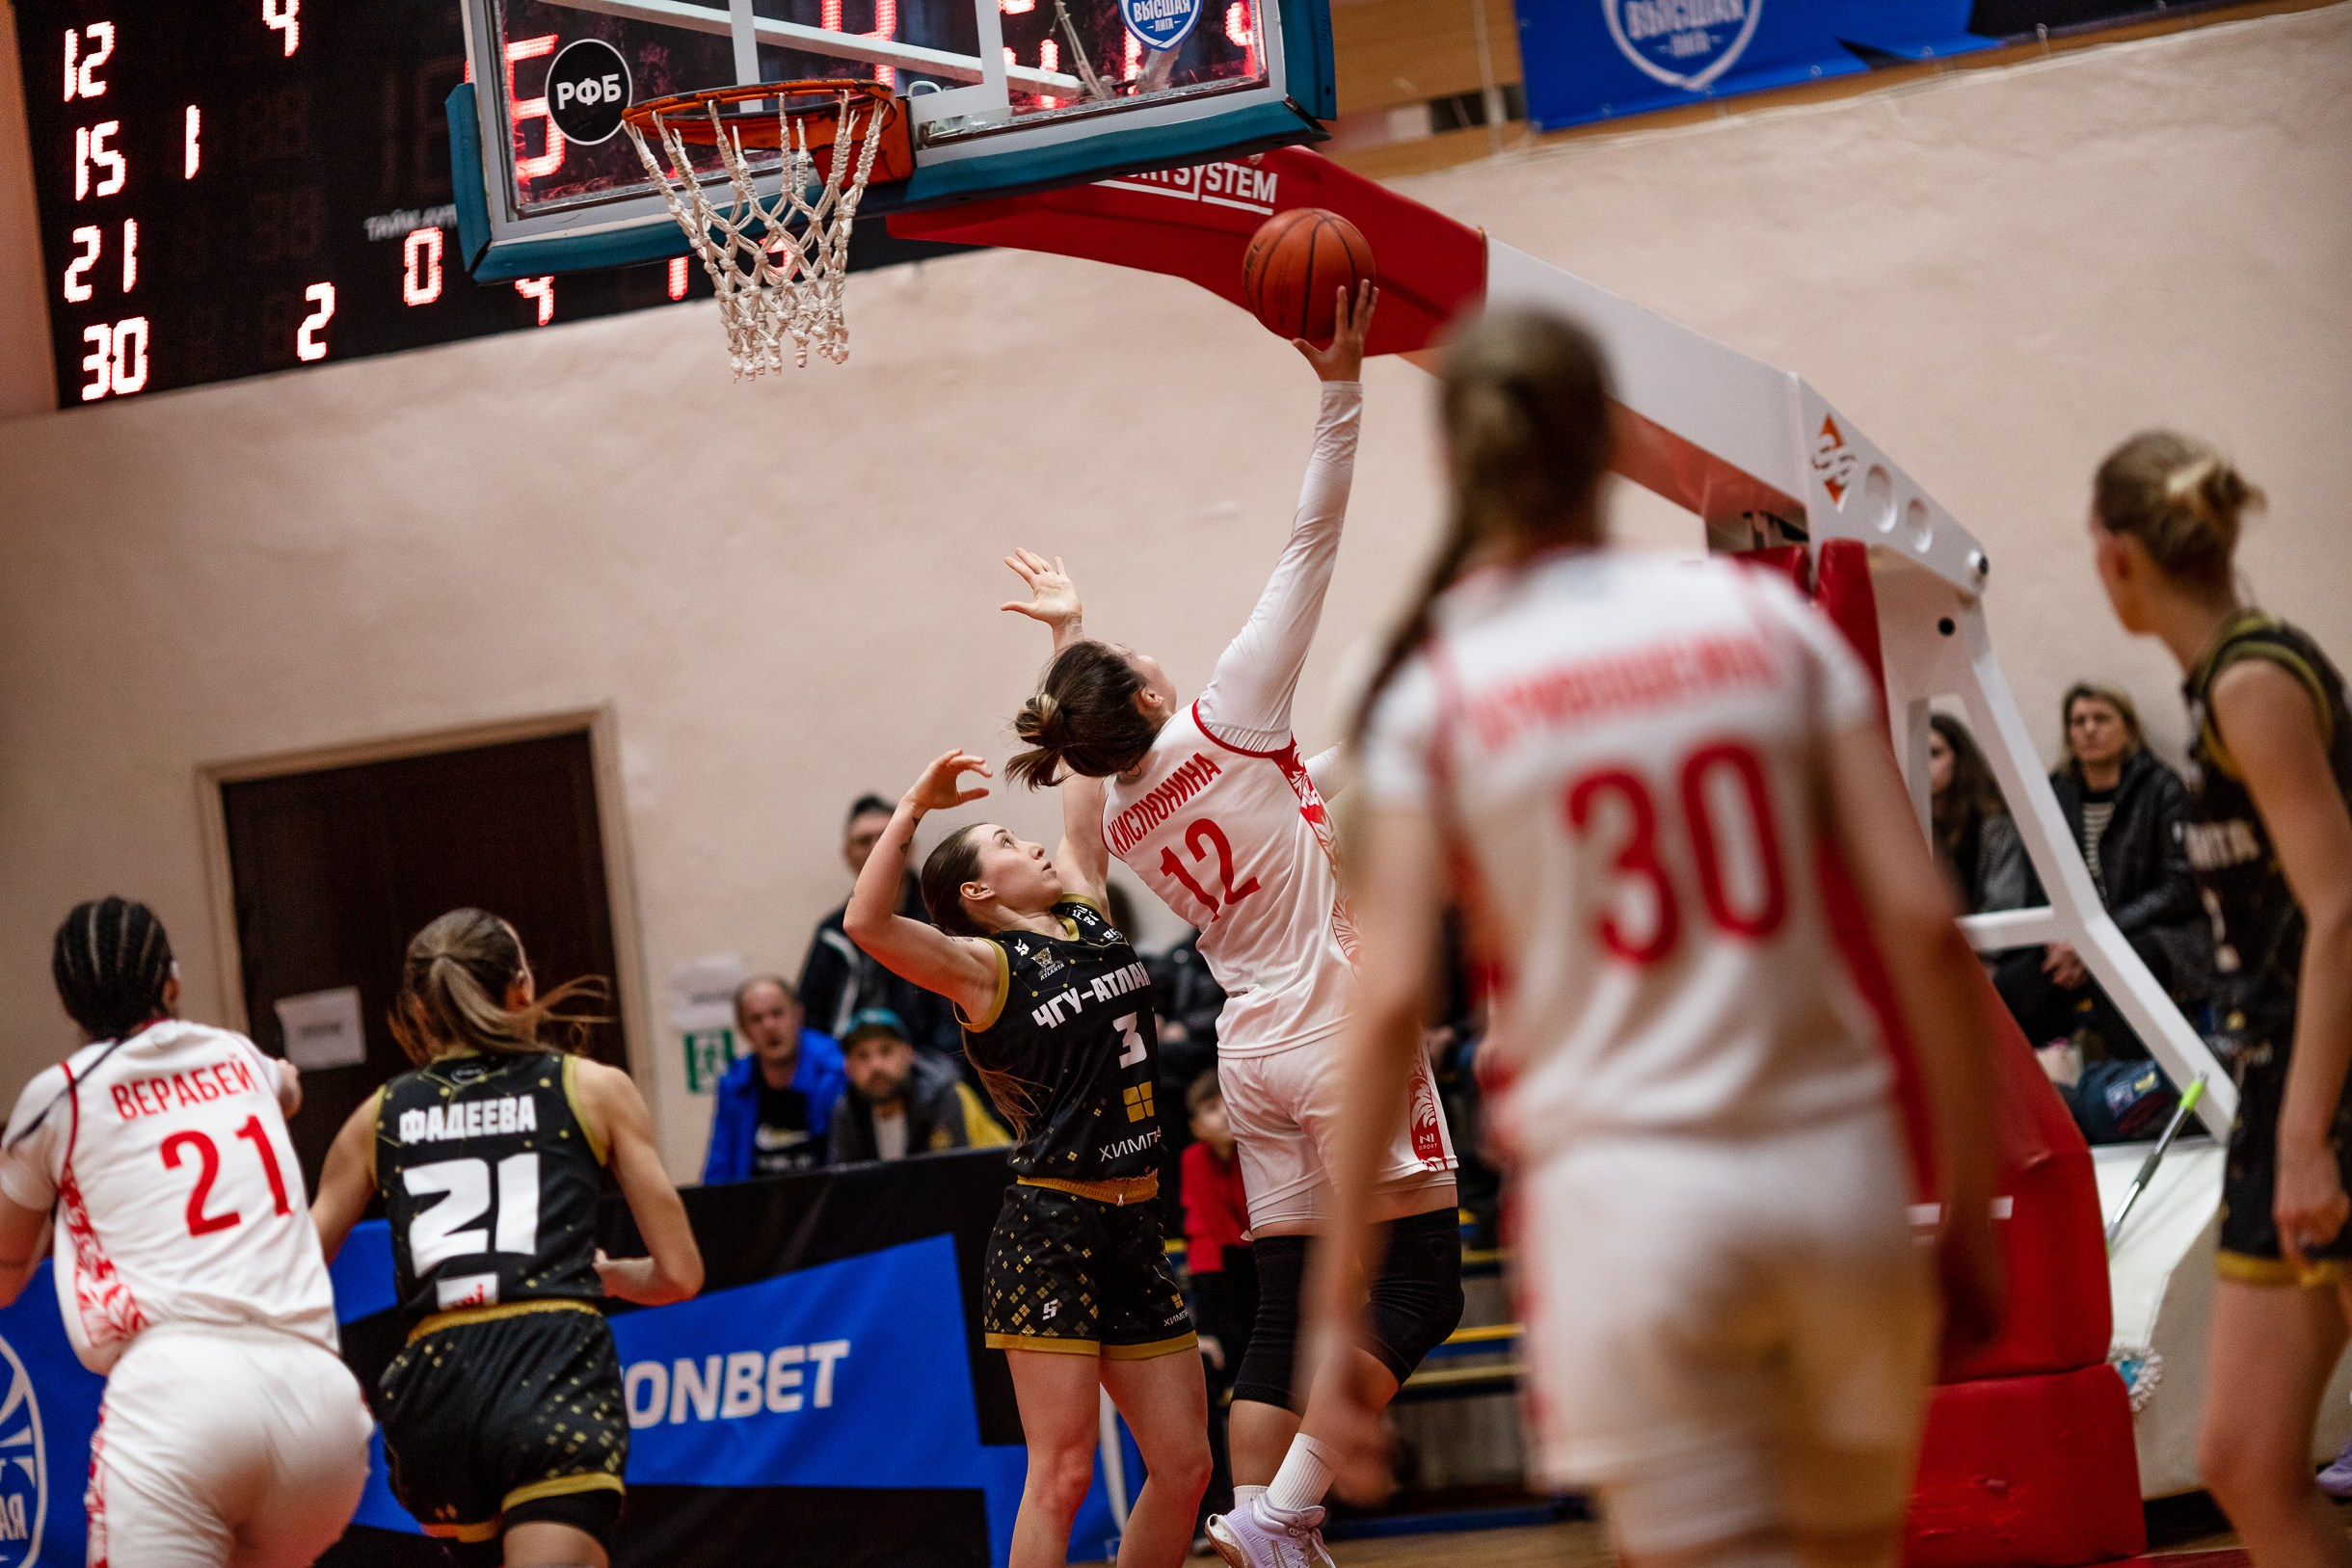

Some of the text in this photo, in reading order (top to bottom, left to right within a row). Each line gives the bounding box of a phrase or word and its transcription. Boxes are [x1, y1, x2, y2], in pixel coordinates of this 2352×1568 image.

[1133, 0, 1191, 23] ВЫСШАЯ
[1155, 17, 1174, 32] ЛИГА
[65, 21, 115, 101] 12
[556, 74, 620, 110] РФБ
[75, 120, 125, 200] 15
[185, 104, 200, 179] 1
[64, 219, 137, 305] 21
[404, 226, 442, 306] 0
[82, 316, 148, 401] 30
[297, 281, 334, 360] 2
[1108, 752, 1222, 856] КИСЛЮНИНА
[1160, 817, 1260, 922] 12
[1565, 737, 1786, 964] 30
[1112, 1011, 1147, 1070] 3
[112, 1059, 258, 1122] ВЕРАБЕЙ
[399, 1095, 537, 1145] ФАДЕЕВА
[158, 1114, 291, 1237] 21
[1099, 1125, 1162, 1162] ХИМП
[402, 1153, 541, 1278] 21
[619, 1341, 850, 1429] ONBET
